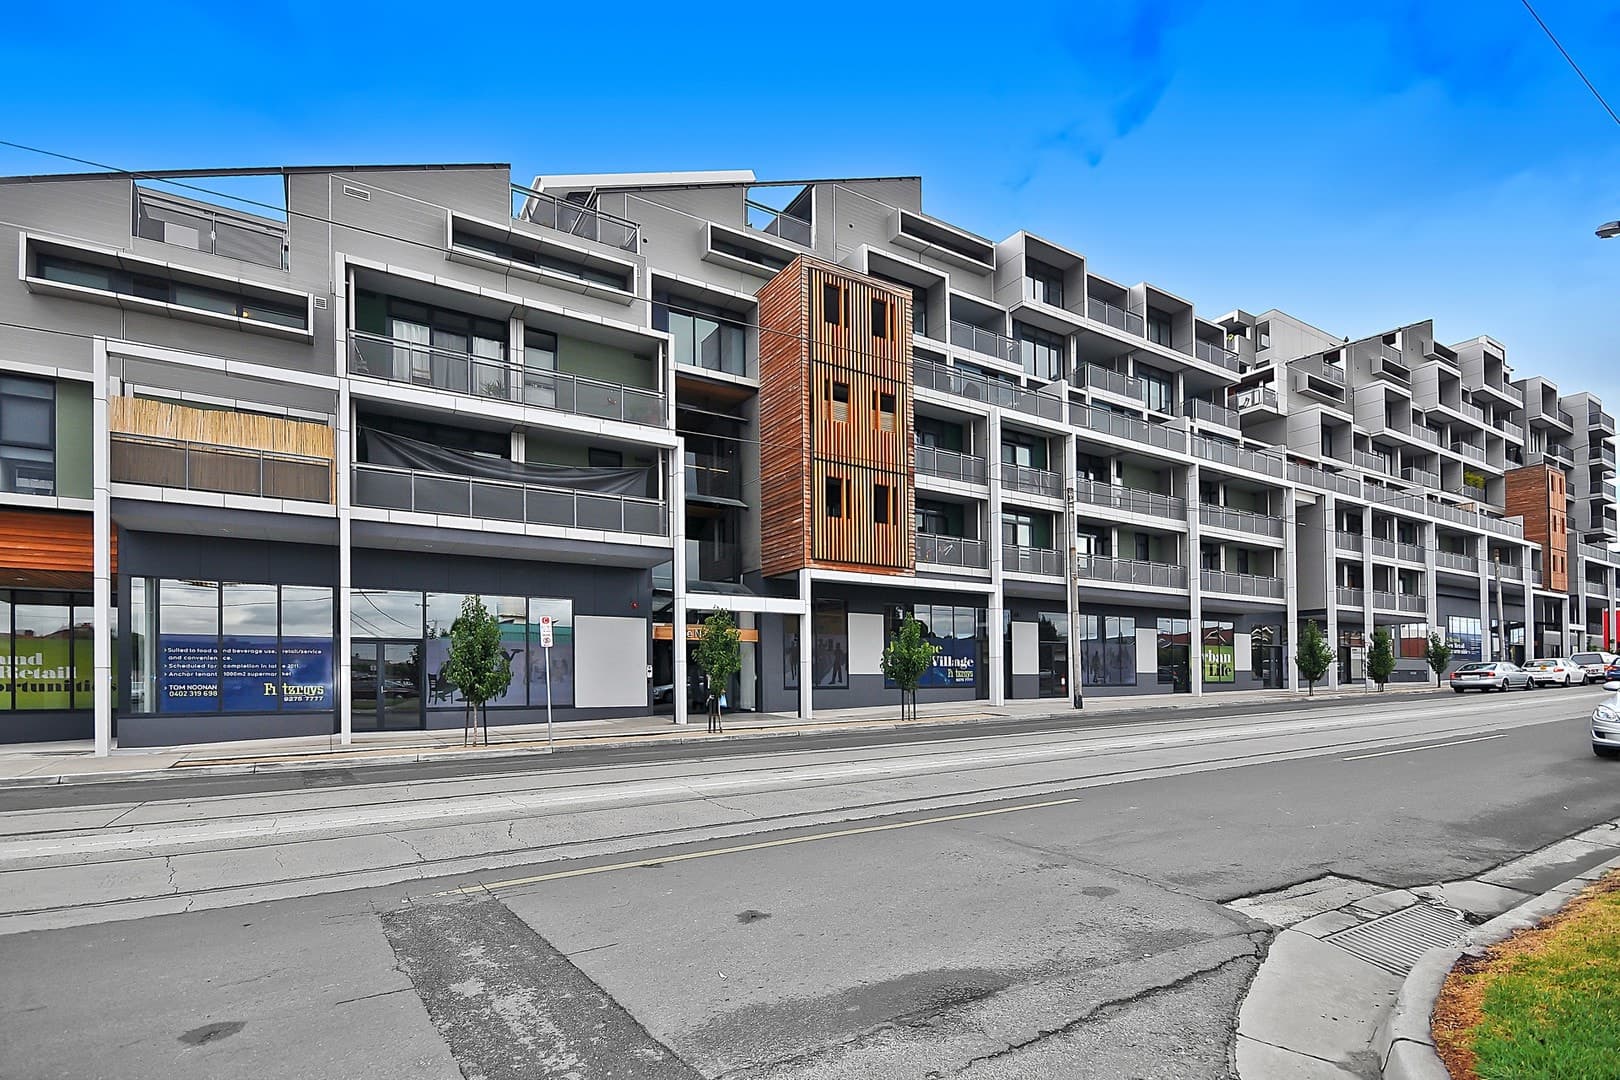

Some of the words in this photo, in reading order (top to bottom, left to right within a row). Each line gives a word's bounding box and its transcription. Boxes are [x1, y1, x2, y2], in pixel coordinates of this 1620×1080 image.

[932, 655, 974, 669] Village
[1201, 650, 1231, 663] rban
[1208, 664, 1232, 677] Life
[263, 682, 324, 696] Fitzroys
